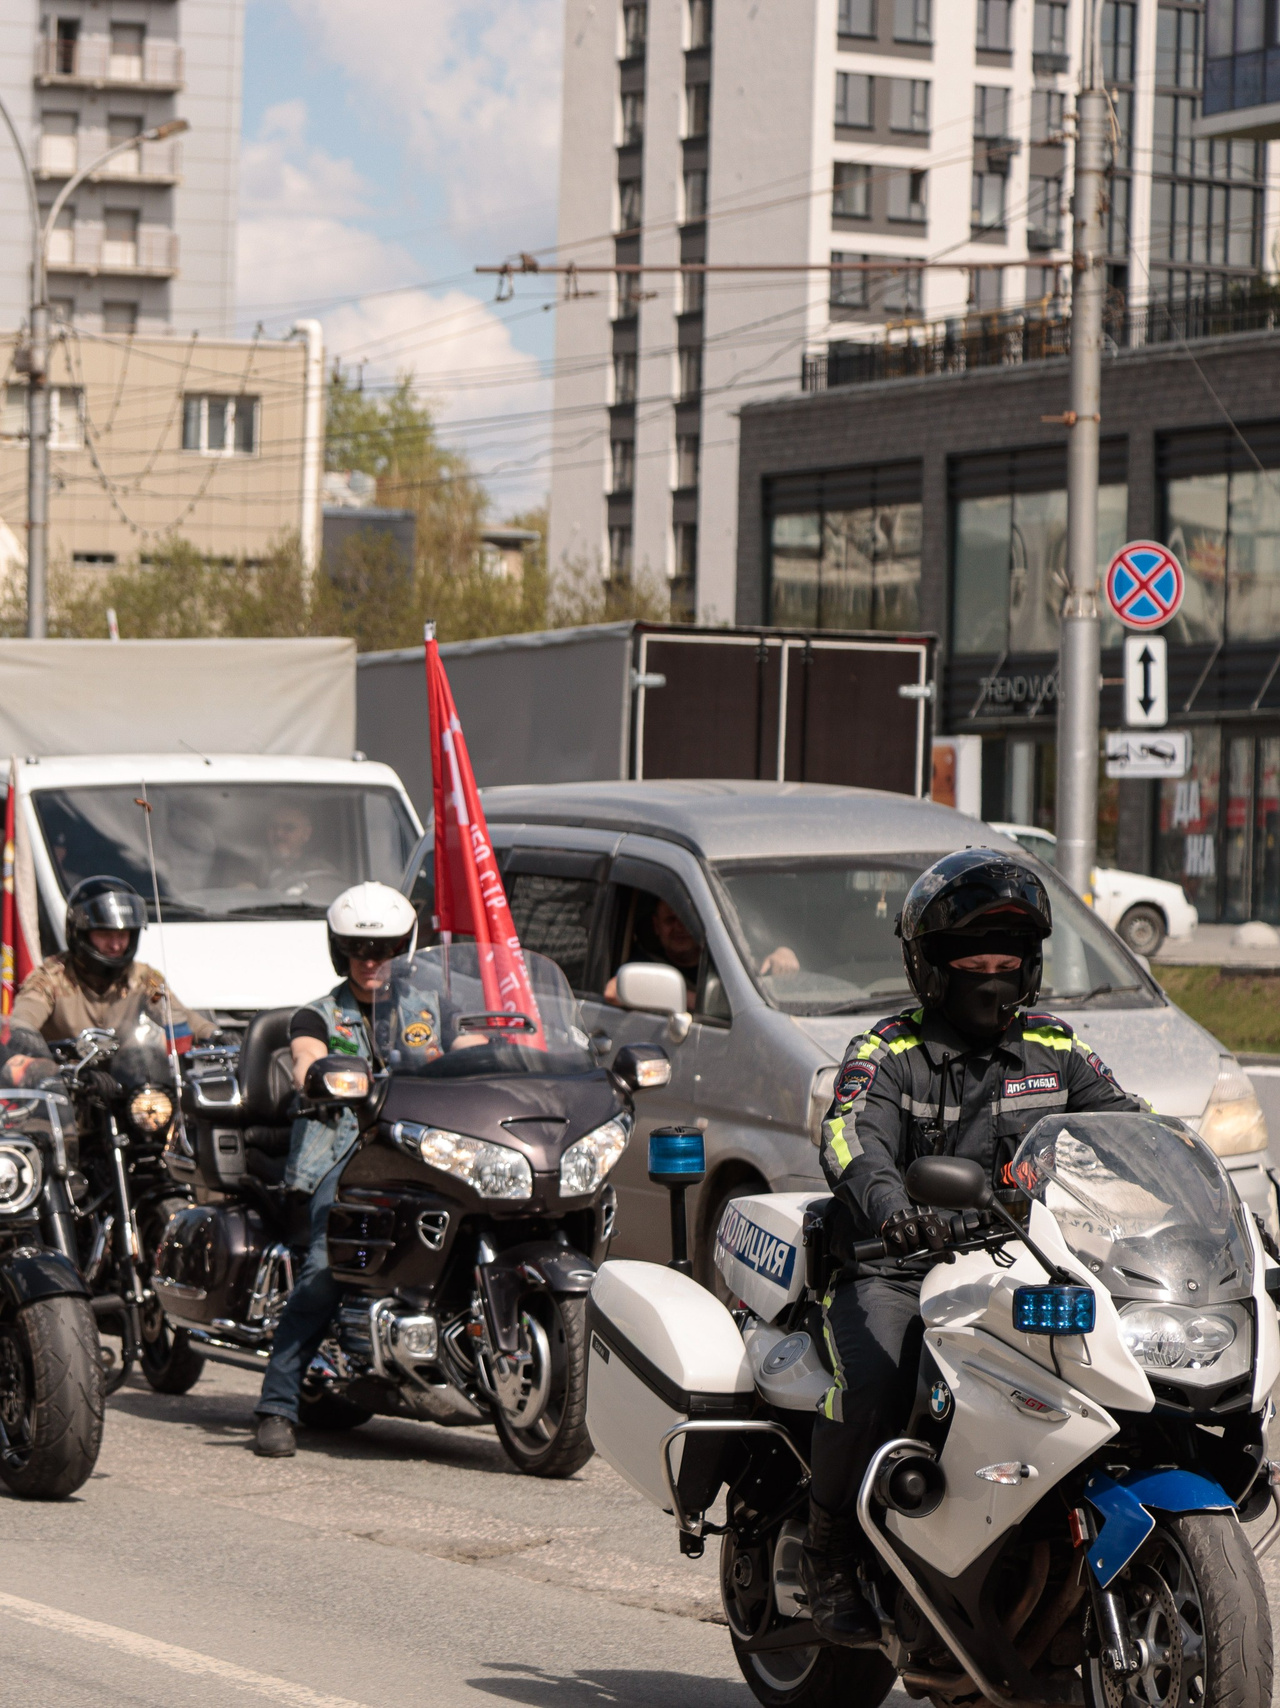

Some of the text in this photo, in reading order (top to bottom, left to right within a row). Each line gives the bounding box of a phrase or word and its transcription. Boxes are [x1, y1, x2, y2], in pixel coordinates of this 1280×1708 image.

[1007, 1076, 1057, 1094] ДПС ГИБДД
[720, 1203, 790, 1278] ПОЛИЦИЯ
